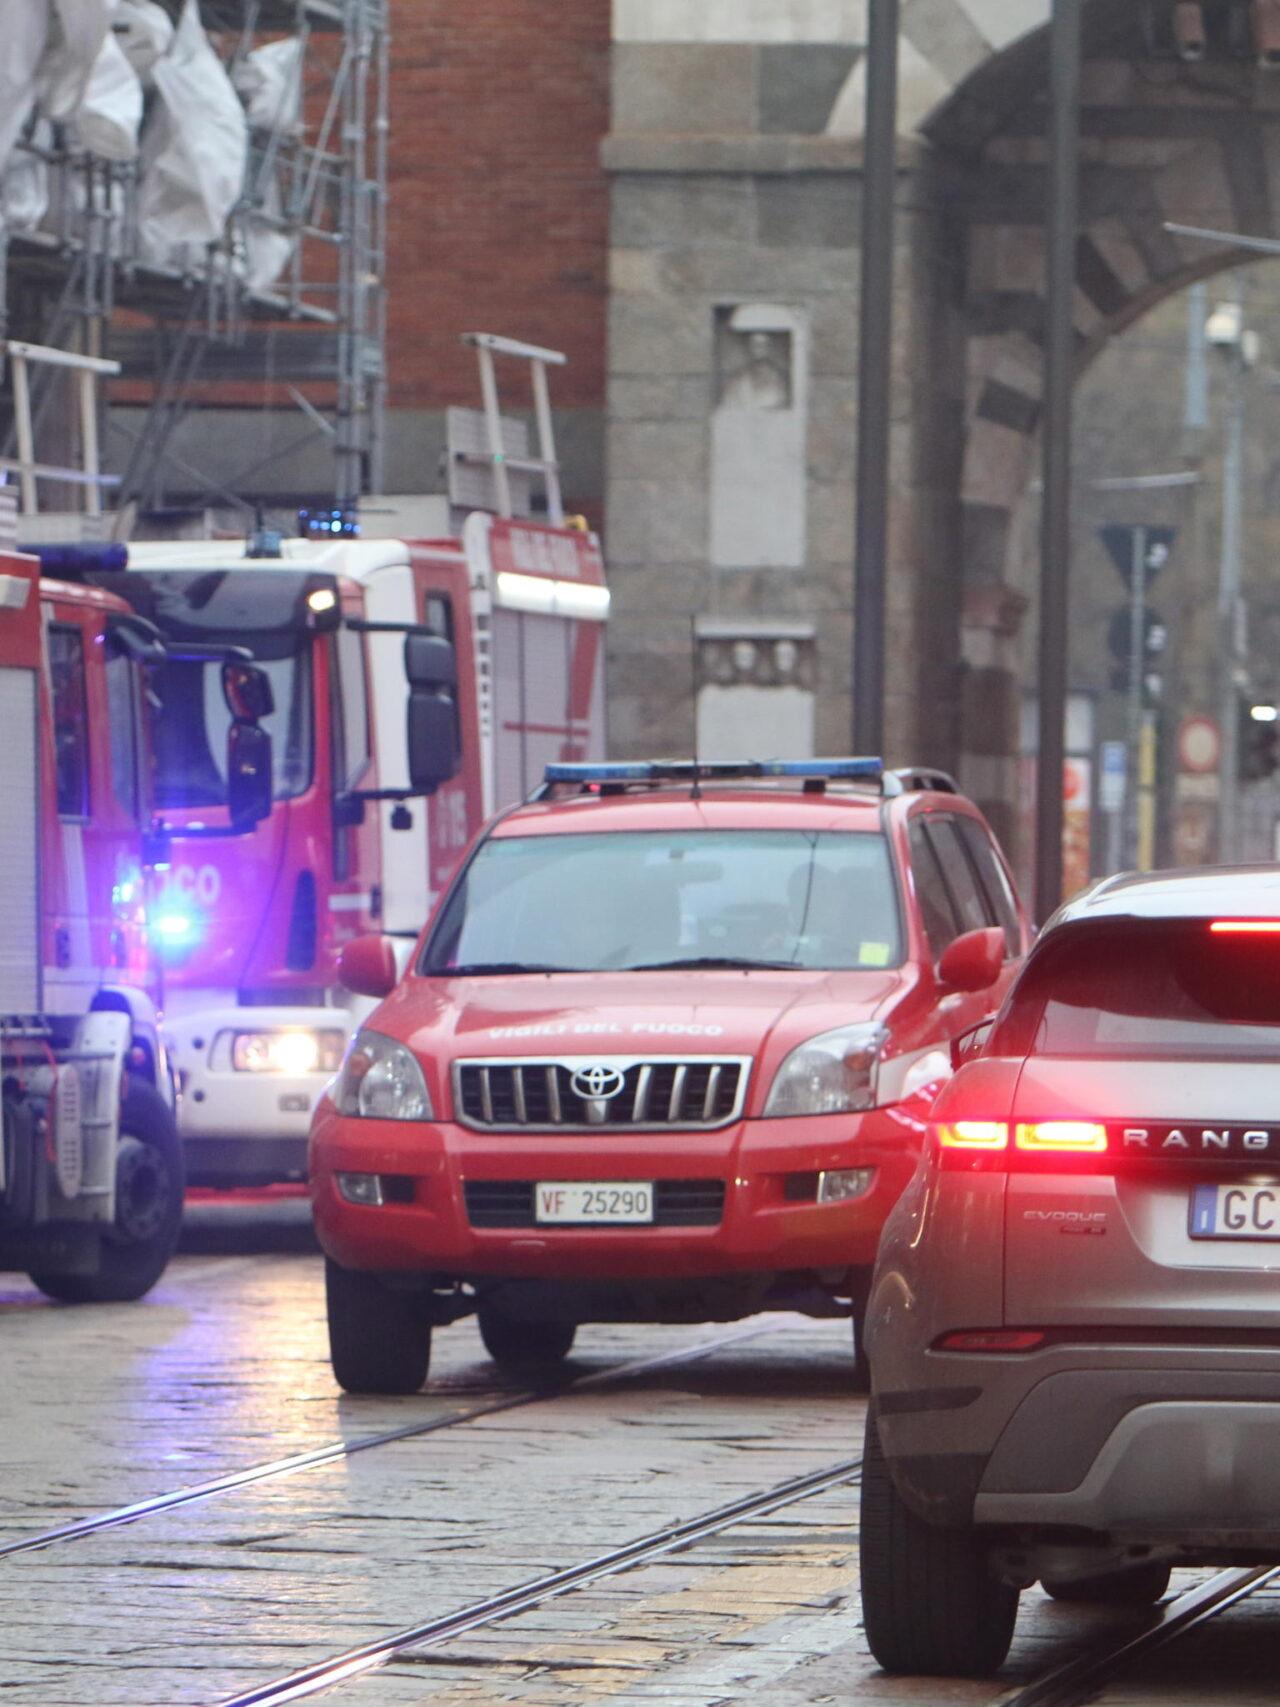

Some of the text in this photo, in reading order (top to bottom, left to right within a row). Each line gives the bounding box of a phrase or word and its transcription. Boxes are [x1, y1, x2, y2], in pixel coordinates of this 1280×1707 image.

[489, 1022, 724, 1038] VIGILI DEL FUOCO
[542, 1190, 648, 1214] VF 25290
[1023, 1211, 1107, 1222] EVOQUE
